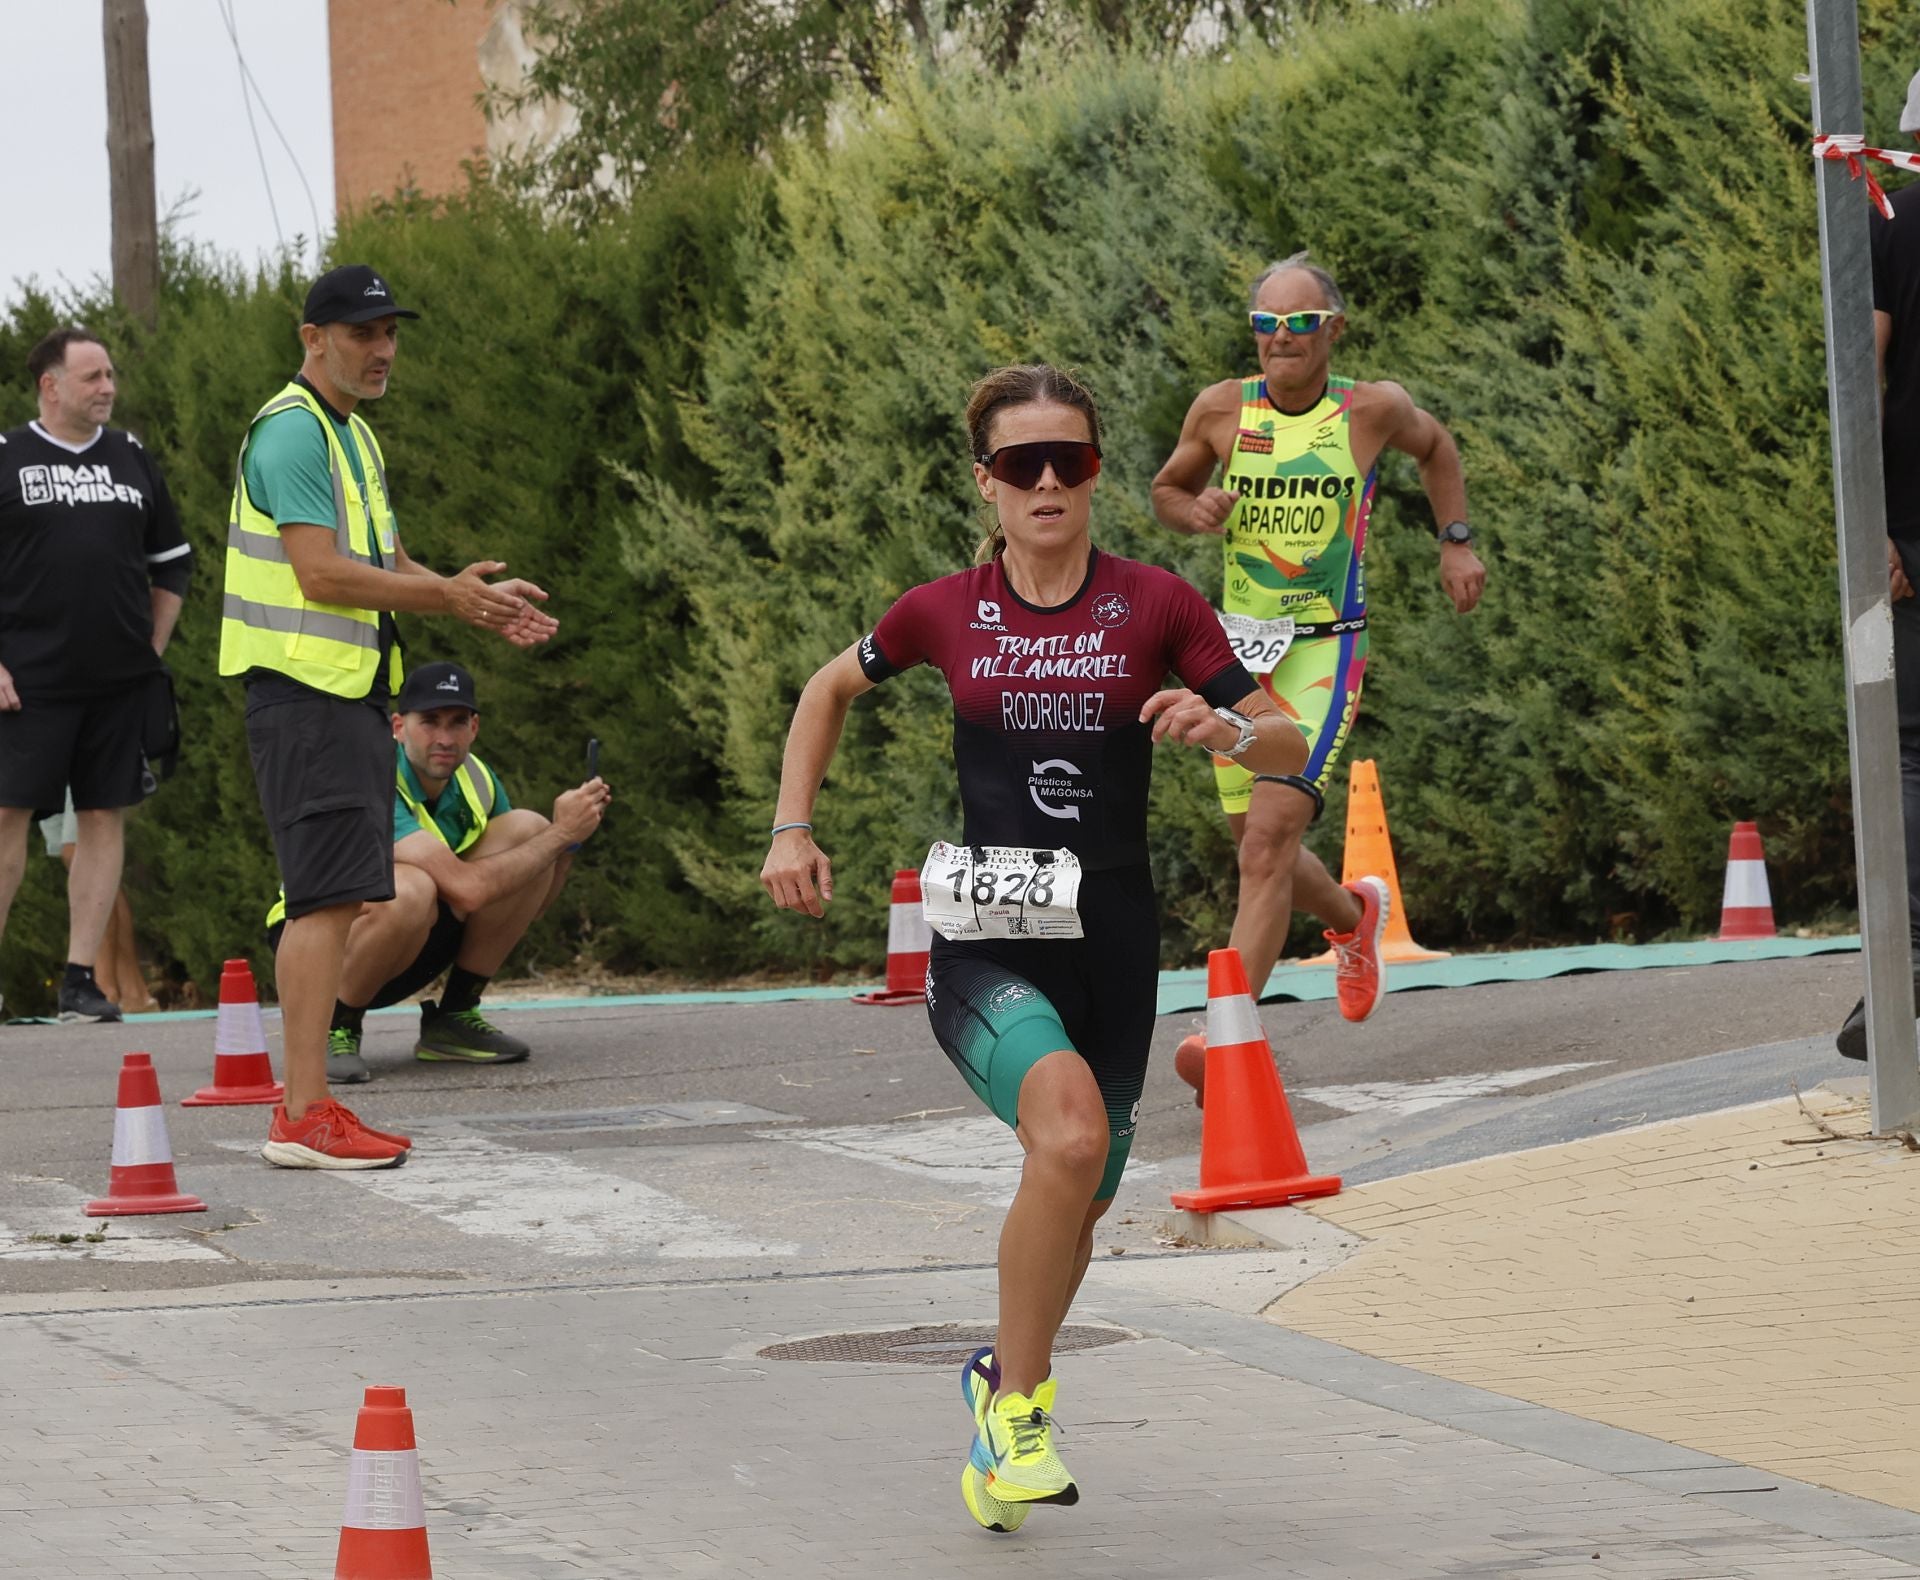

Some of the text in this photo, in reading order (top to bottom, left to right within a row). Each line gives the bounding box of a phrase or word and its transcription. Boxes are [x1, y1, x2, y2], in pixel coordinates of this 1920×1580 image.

[51, 465, 113, 486] IRON
[53, 484, 143, 510] MAIDEN
[1239, 504, 1324, 534] APARICIO
[1281, 588, 1334, 606] grupart
[995, 630, 1105, 658] TRIATLÓN
[970, 655, 1132, 681] VILLAMURIEL
[1002, 691, 1105, 731] RODRIGUEZ
[1028, 777, 1072, 787] Plásticos
[1041, 787, 1094, 798] MAGONSA
[946, 868, 1056, 908] 1828
